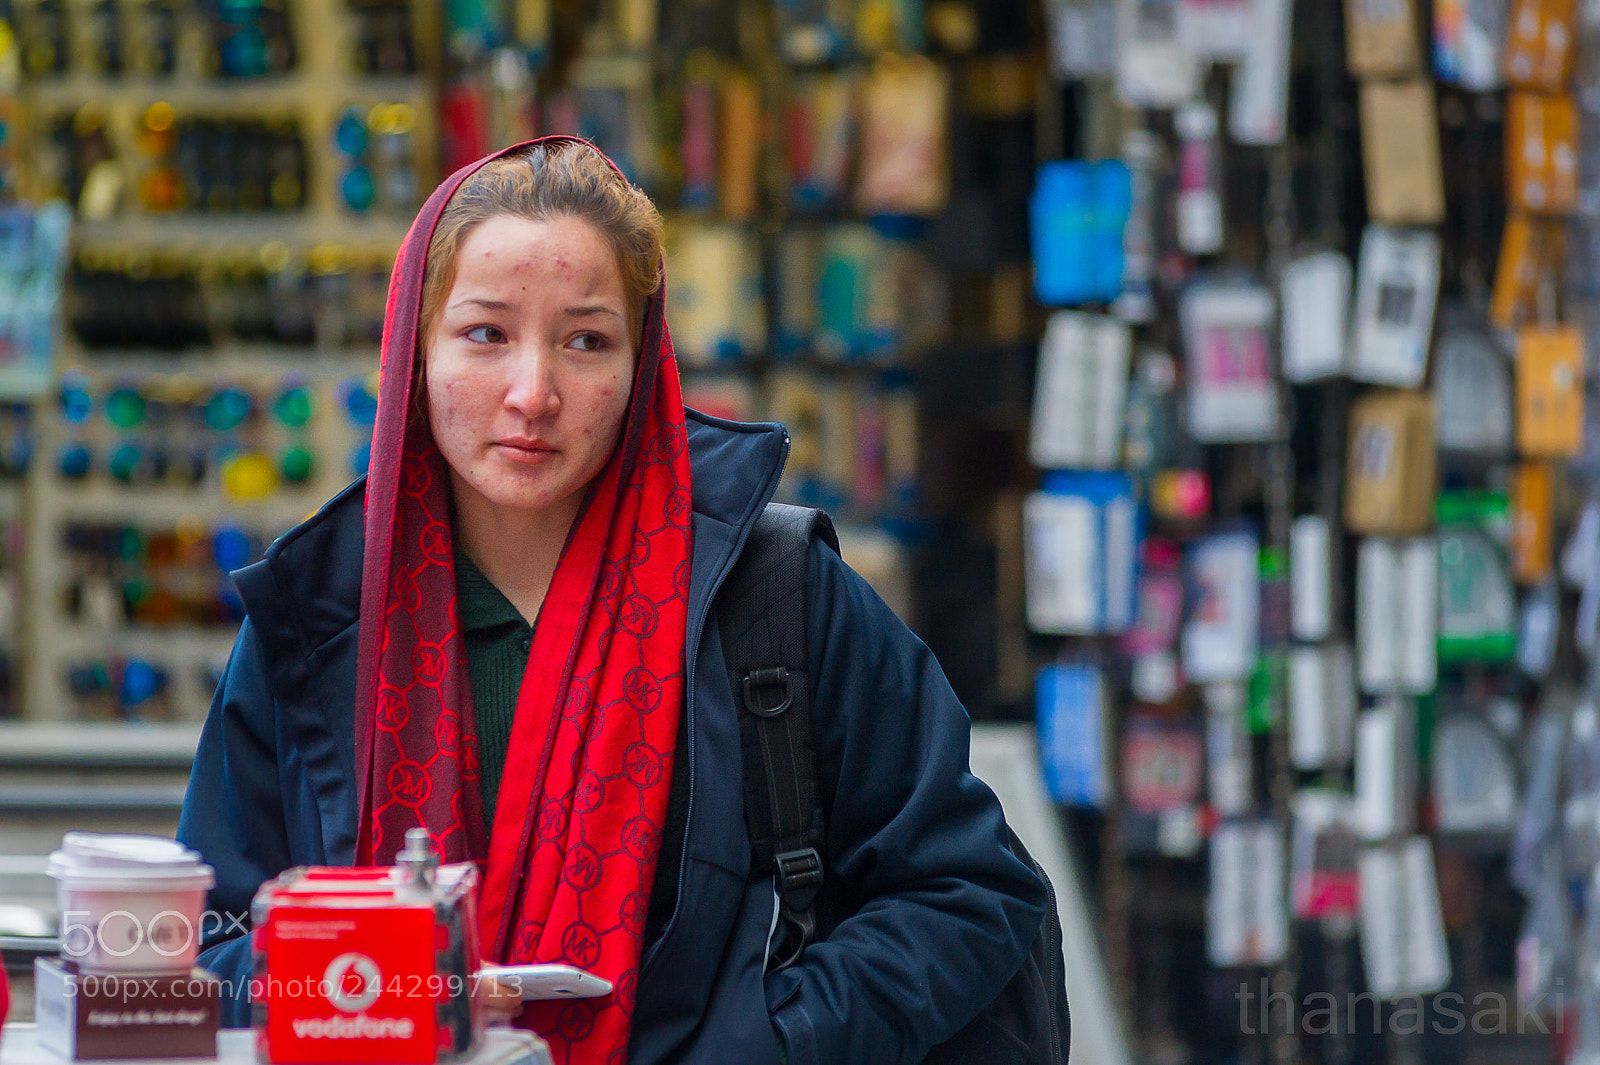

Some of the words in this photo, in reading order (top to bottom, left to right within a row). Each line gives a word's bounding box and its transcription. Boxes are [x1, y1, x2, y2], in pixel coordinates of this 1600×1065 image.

[626, 672, 659, 707] MK
[628, 749, 658, 784] MK
[566, 849, 596, 881] MK
[565, 928, 596, 965] MK
[292, 1013, 415, 1039] vodafone
